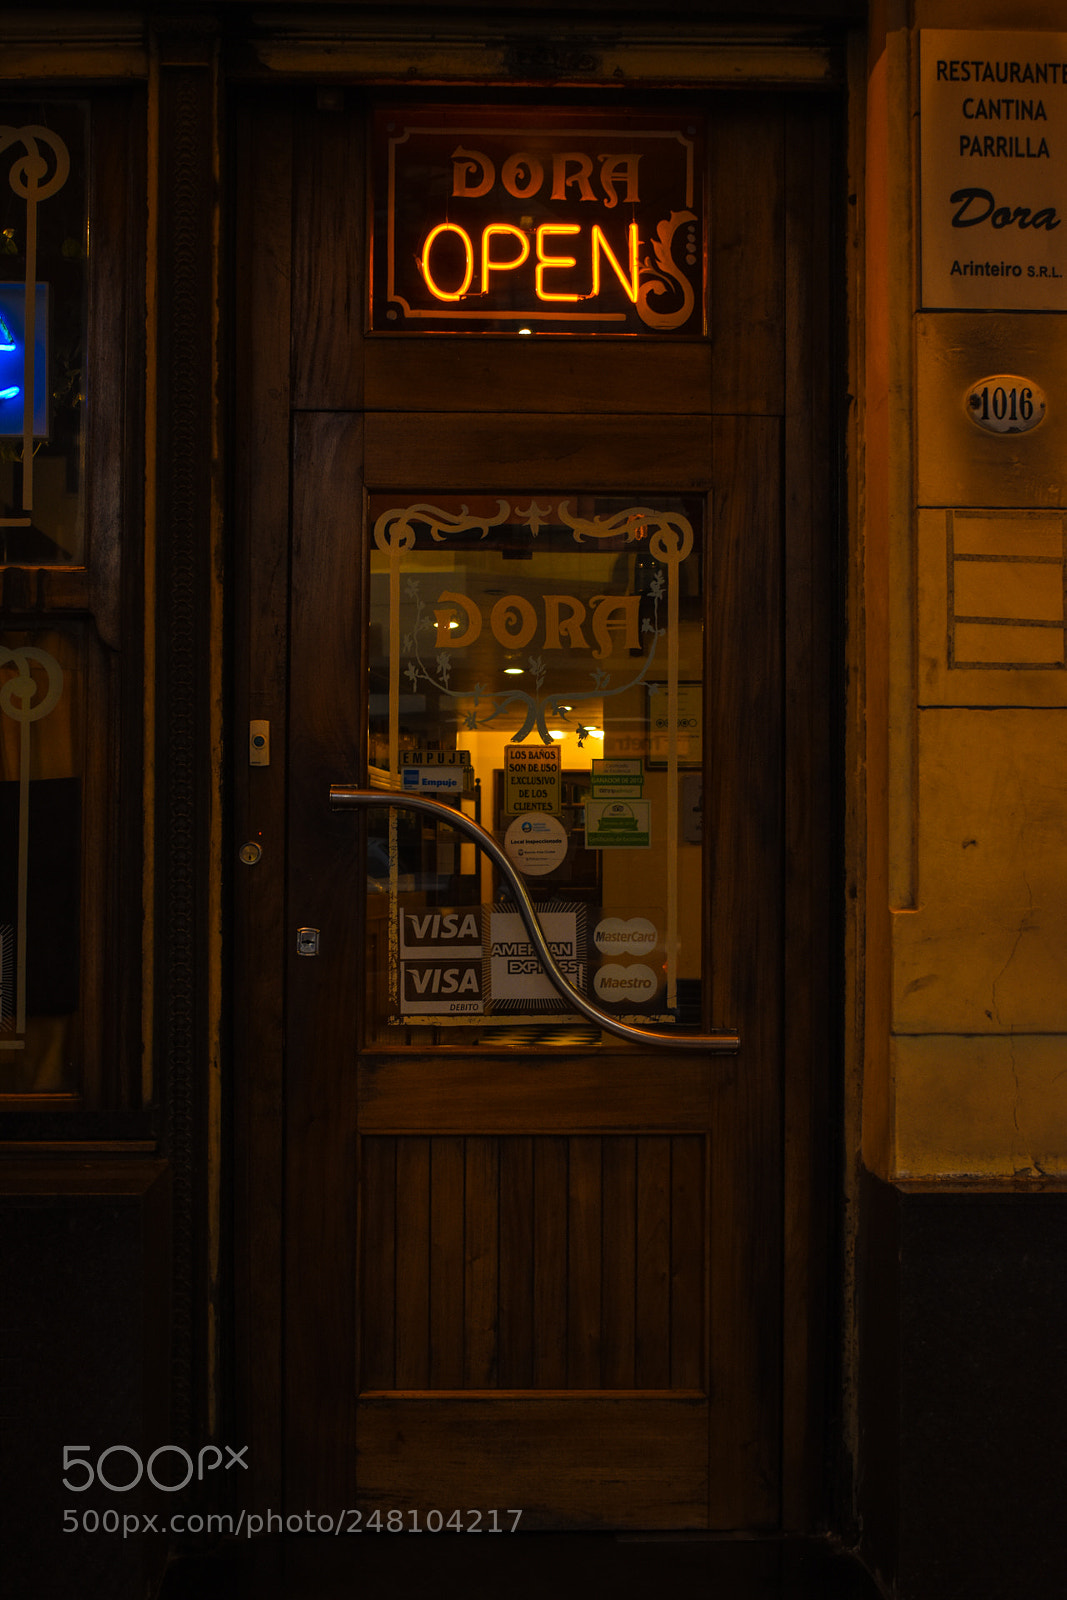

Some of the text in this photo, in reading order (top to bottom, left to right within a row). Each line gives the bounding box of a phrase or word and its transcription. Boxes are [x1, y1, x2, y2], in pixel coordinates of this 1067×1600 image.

[937, 60, 1067, 84] RESTAURANTE
[963, 98, 1047, 121] CANTINA
[960, 135, 1050, 158] PARRILLA
[451, 145, 644, 208] DORA
[950, 188, 1061, 231] Dora
[421, 222, 639, 304] OPEN
[950, 260, 1063, 278] Arinteiro S.R.L.
[981, 387, 1033, 420] 1016
[433, 590, 642, 660] DORA
[403, 752, 465, 764] EMPUJE
[510, 749, 556, 759] LOS BAÑOS
[509, 763, 557, 772] SON DE USO
[422, 778, 457, 788] Empuje
[511, 776, 556, 785] EXCLUSIVO
[519, 789, 546, 798] DE LOS
[513, 802, 553, 811] CLIENTES
[405, 914, 479, 939] VISA
[595, 931, 656, 942] MasterCard
[491, 942, 573, 957] AMERAN
[508, 960, 579, 974] EXPSS
[405, 968, 480, 994] VISA
[600, 977, 652, 989] Maestro
[450, 1003, 479, 1011] DEBITO
